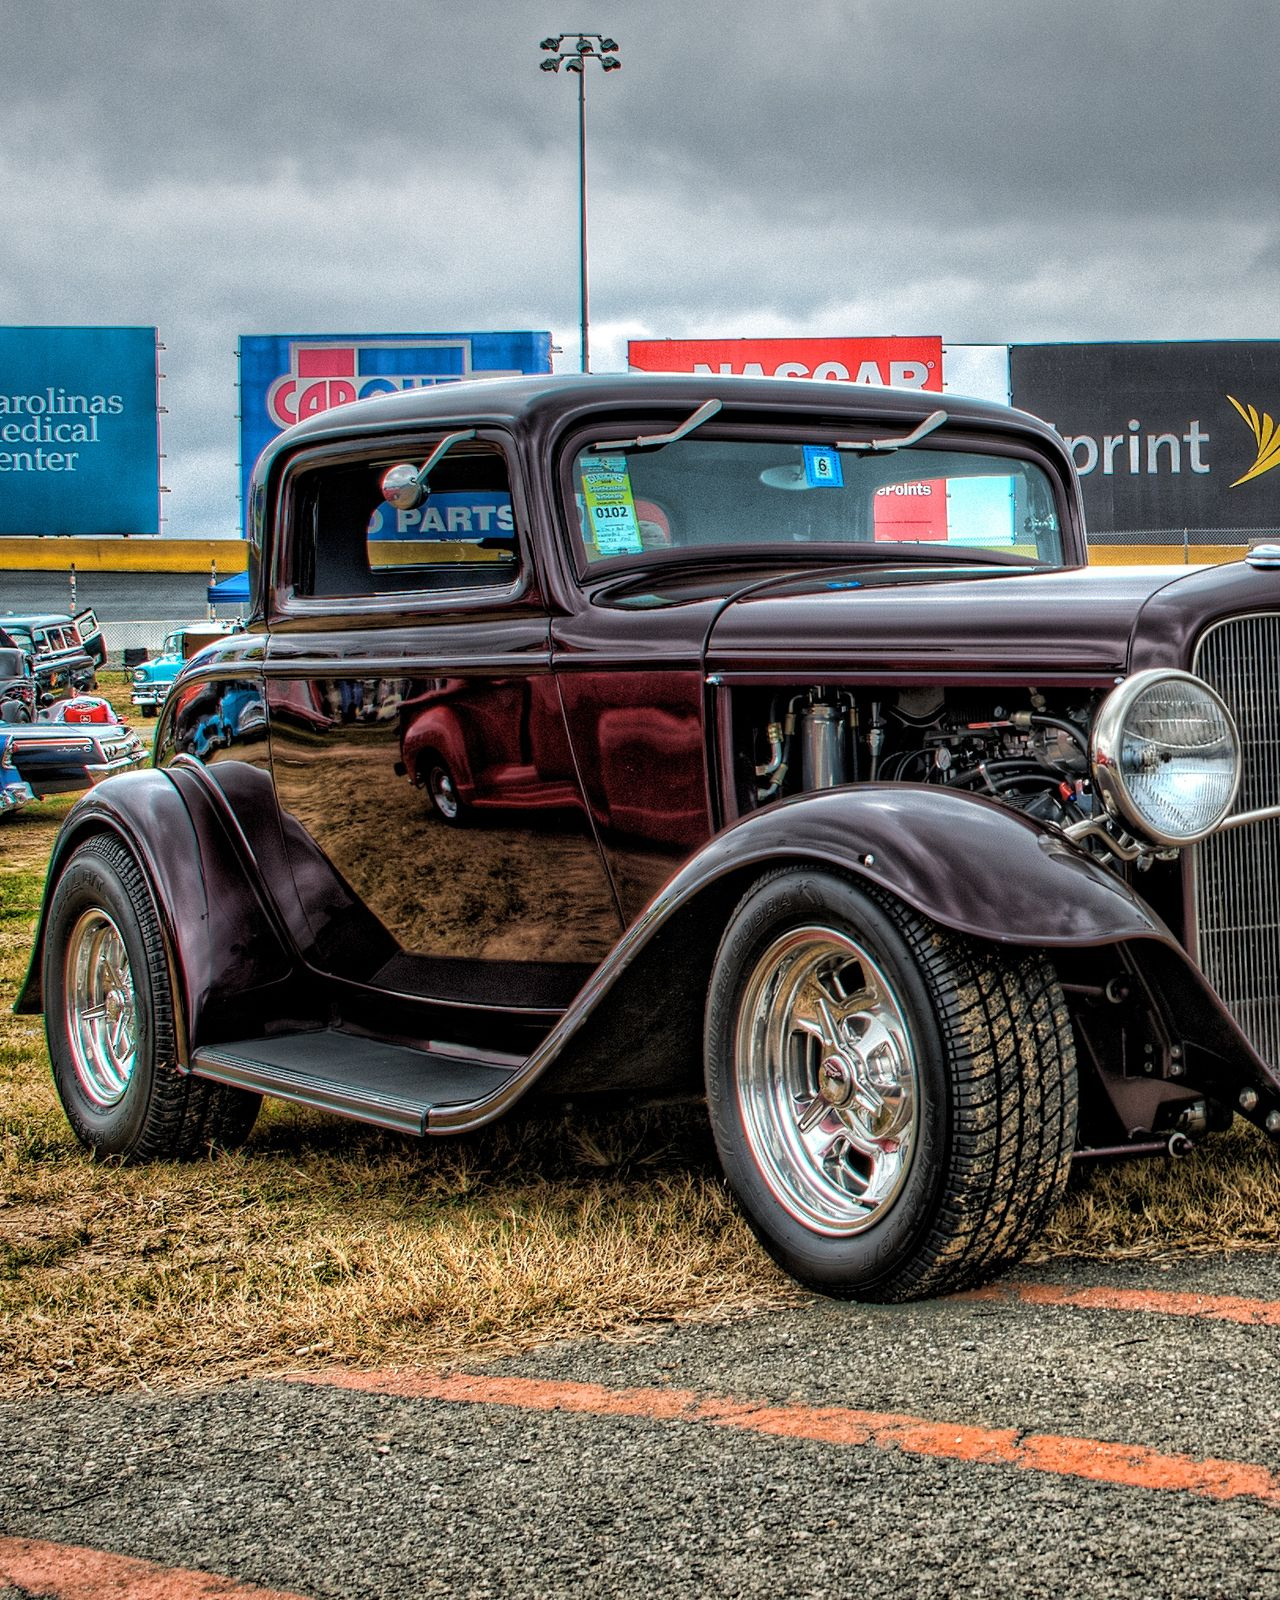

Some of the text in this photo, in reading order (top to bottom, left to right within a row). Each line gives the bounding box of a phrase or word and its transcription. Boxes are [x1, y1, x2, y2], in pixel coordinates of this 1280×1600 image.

[0, 387, 124, 414] arolinas
[0, 415, 101, 443] edical
[0, 447, 80, 472] enter
[1062, 419, 1211, 475] print
[818, 458, 827, 472] 6
[396, 505, 514, 533] PARTS
[596, 507, 628, 518] 0102
[733, 892, 792, 955] COBRA
